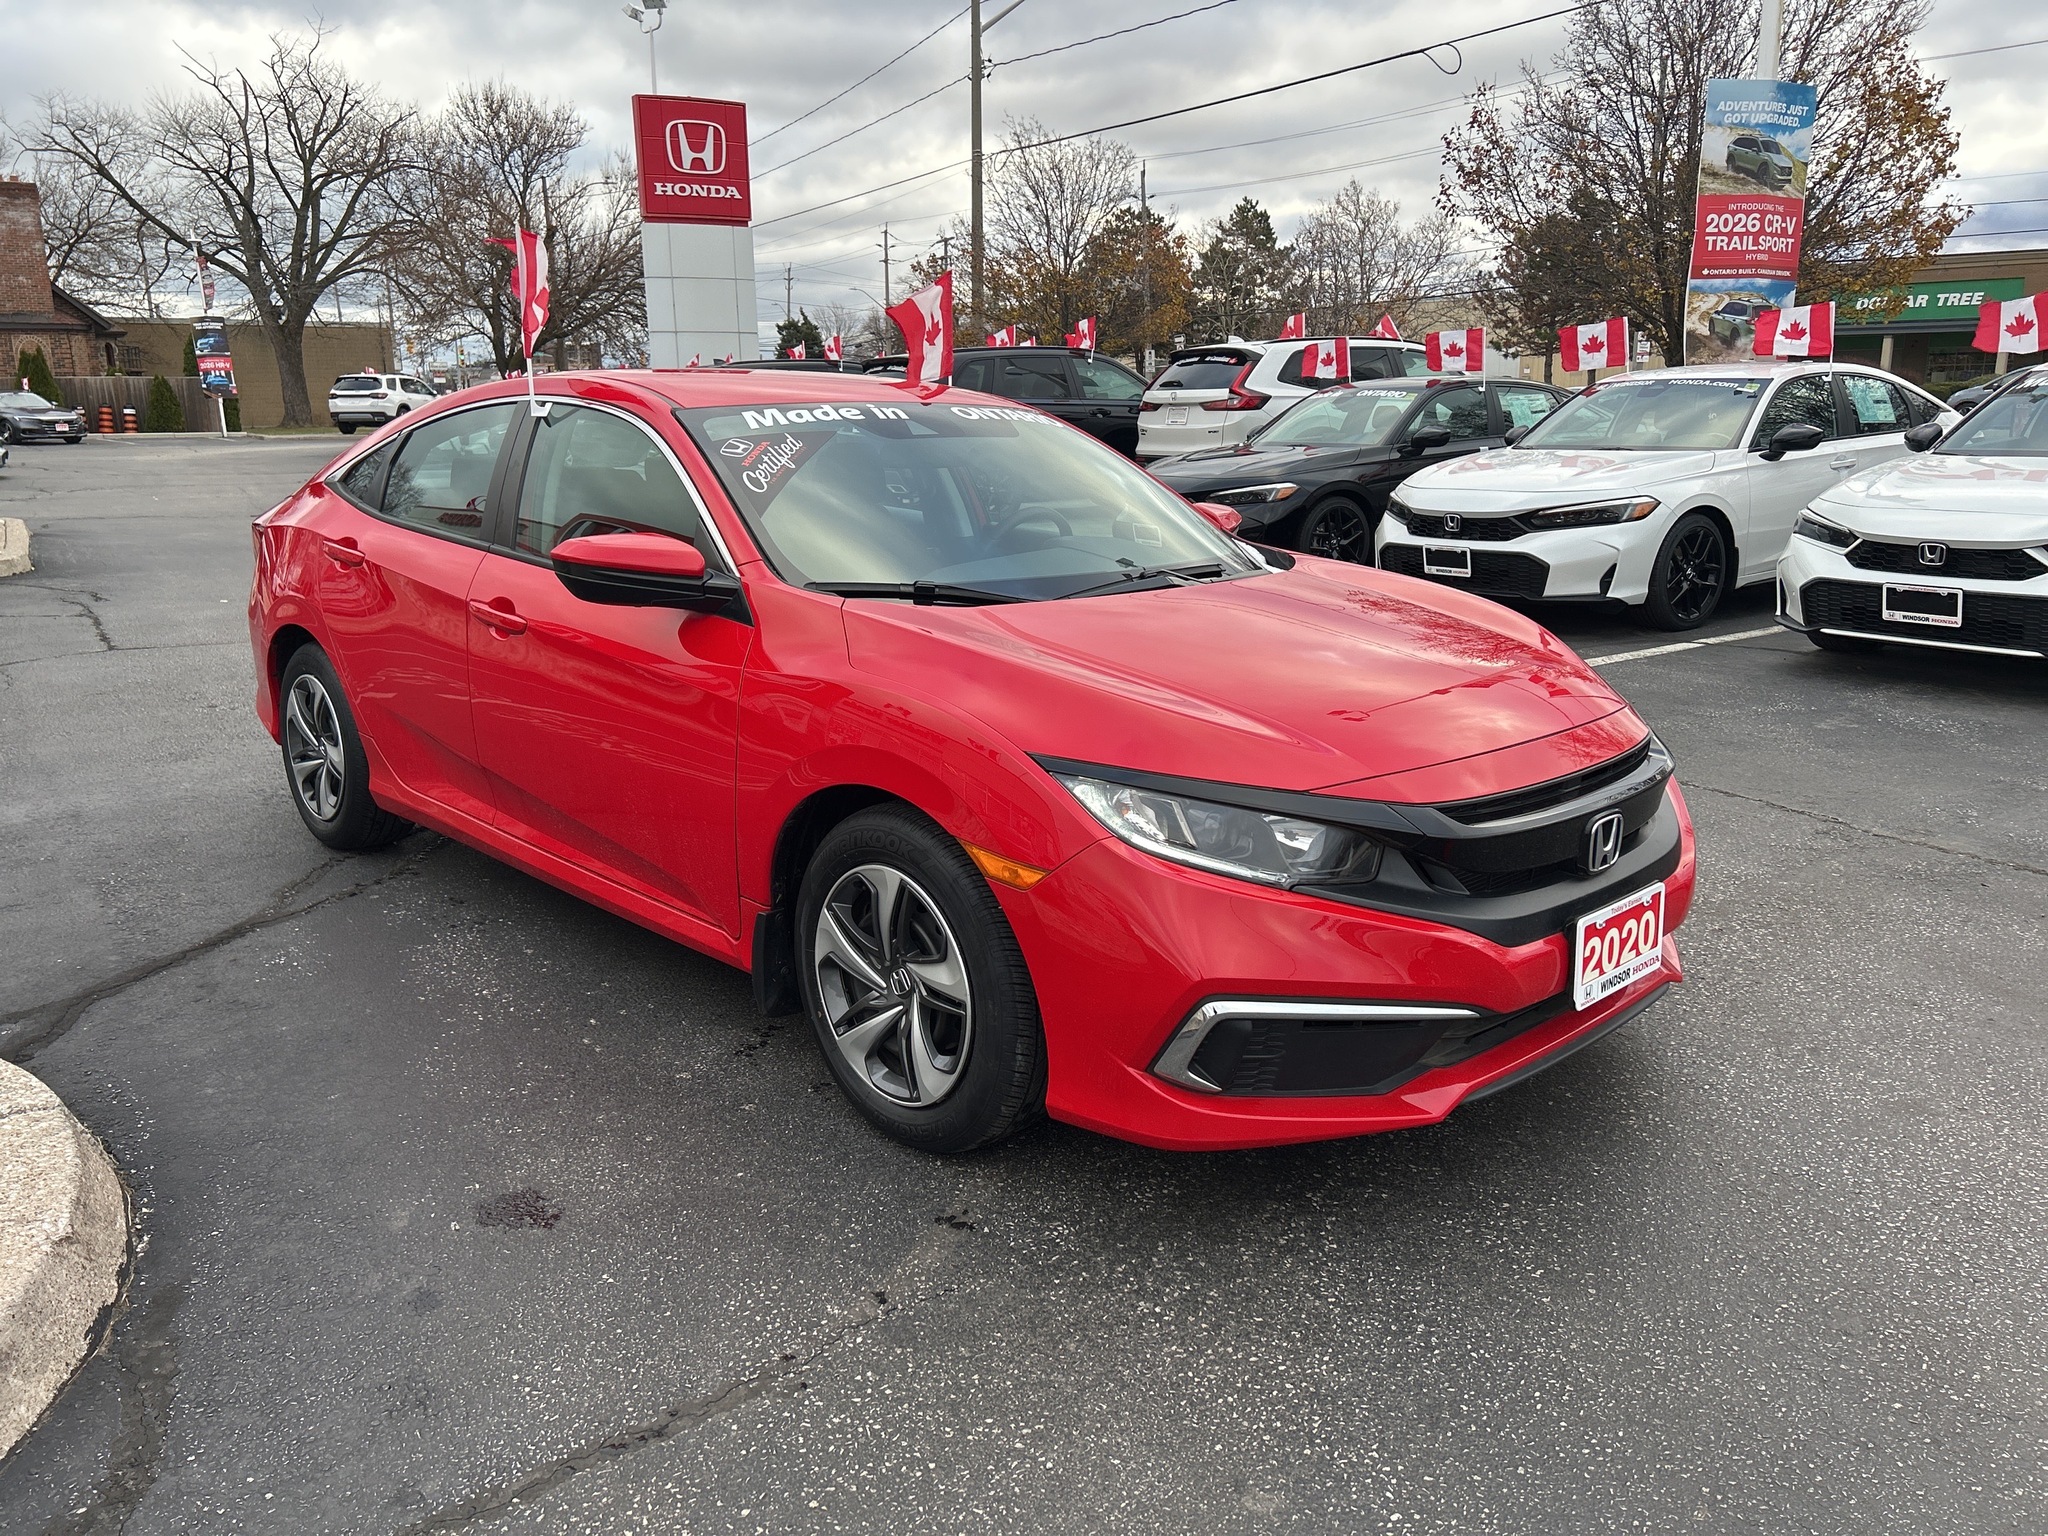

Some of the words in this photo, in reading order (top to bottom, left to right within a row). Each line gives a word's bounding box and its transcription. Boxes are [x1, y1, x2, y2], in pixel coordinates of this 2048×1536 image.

[1716, 100, 1787, 113] ADVENTURES
[1787, 104, 1809, 117] JUST
[1724, 112, 1748, 124] GOT
[1751, 113, 1801, 128] UPGRADED.
[653, 182, 743, 200] HONDA
[1728, 203, 1774, 211] INTRODUCING
[1775, 204, 1785, 212] THE
[1705, 213, 1761, 233] 2026
[1764, 214, 1797, 235] CR-V
[1705, 235, 1795, 254] TRAILSPORT
[1745, 253, 1769, 261] HYBRID
[1738, 267, 1757, 275] BUILT.
[1937, 291, 1984, 307] TREE
[1668, 379, 1739, 389] HONDA.com
[1356, 389, 1408, 398] ONTARIO
[741, 405, 866, 430] Made
[865, 404, 910, 420] in
[741, 441, 771, 467] HONDA
[742, 432, 803, 493] Certified
[1902, 614, 1930, 623] WINDSOR
[1583, 911, 1655, 983] 2020
[1600, 968, 1631, 993] WINDSOR
[1632, 955, 1660, 976] HONDA
